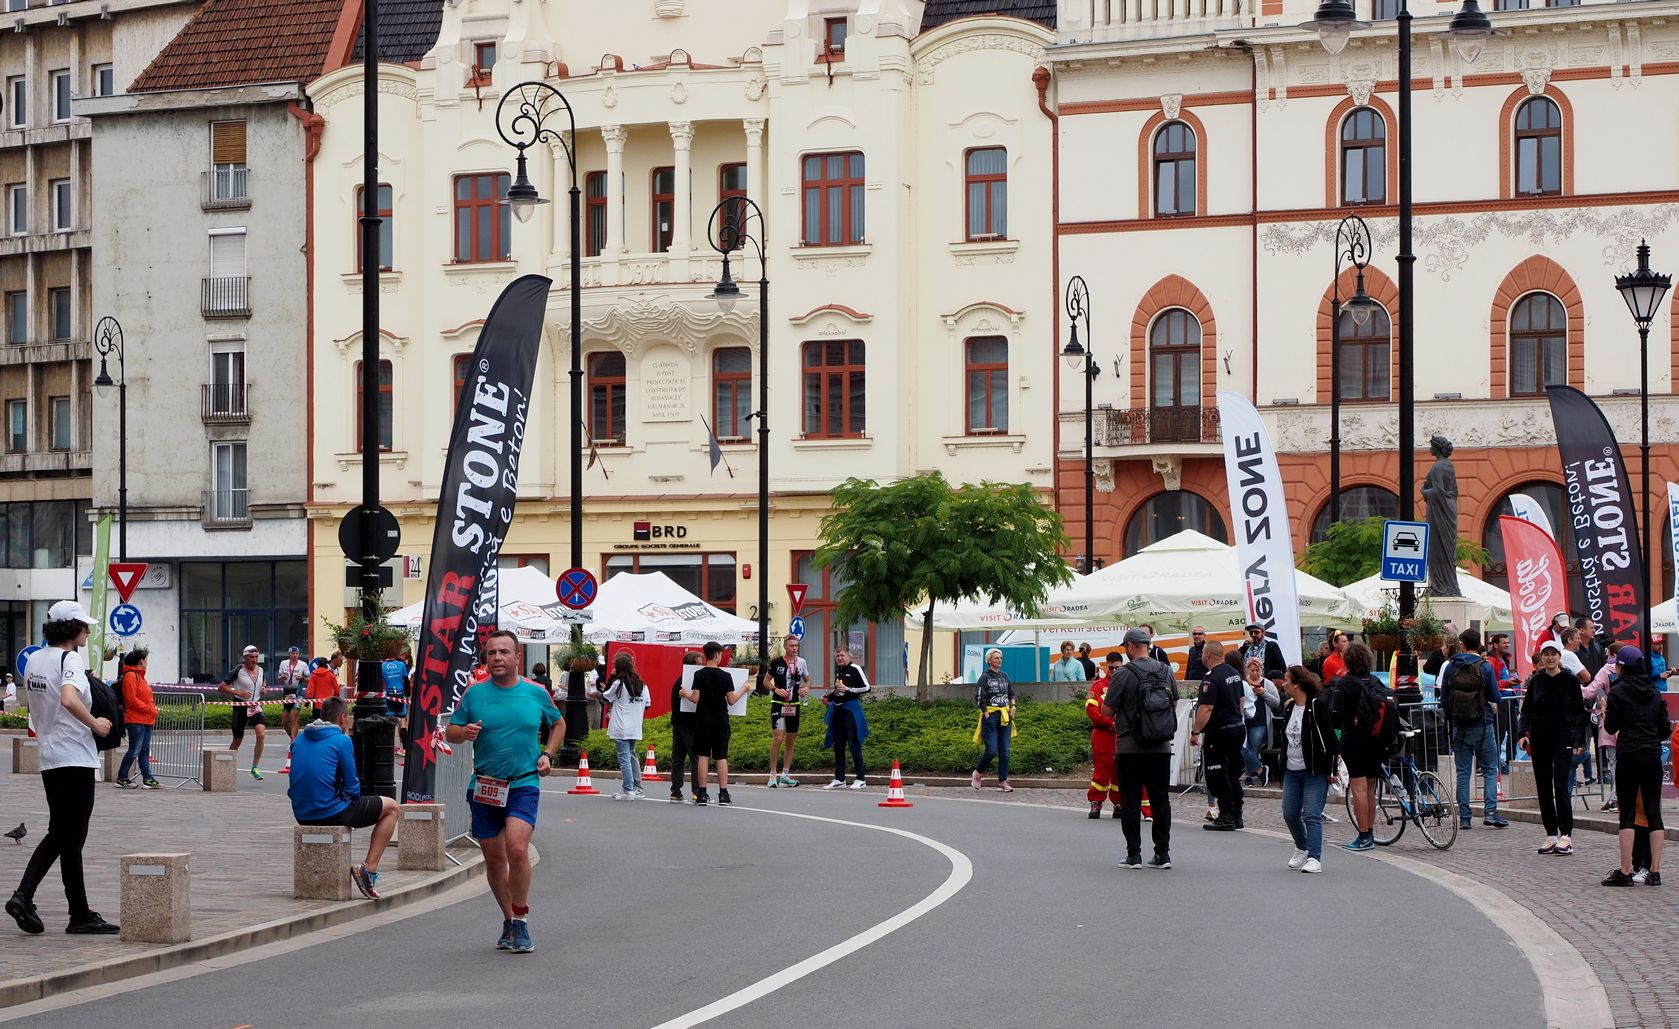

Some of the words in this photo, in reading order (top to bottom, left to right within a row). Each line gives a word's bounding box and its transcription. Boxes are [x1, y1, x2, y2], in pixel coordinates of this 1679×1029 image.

[503, 388, 526, 494] Beton!
[501, 506, 511, 523] e
[652, 526, 687, 538] BRD
[1390, 562, 1419, 576] TAXI
[420, 571, 476, 716] STAR
[480, 785, 499, 797] 609
